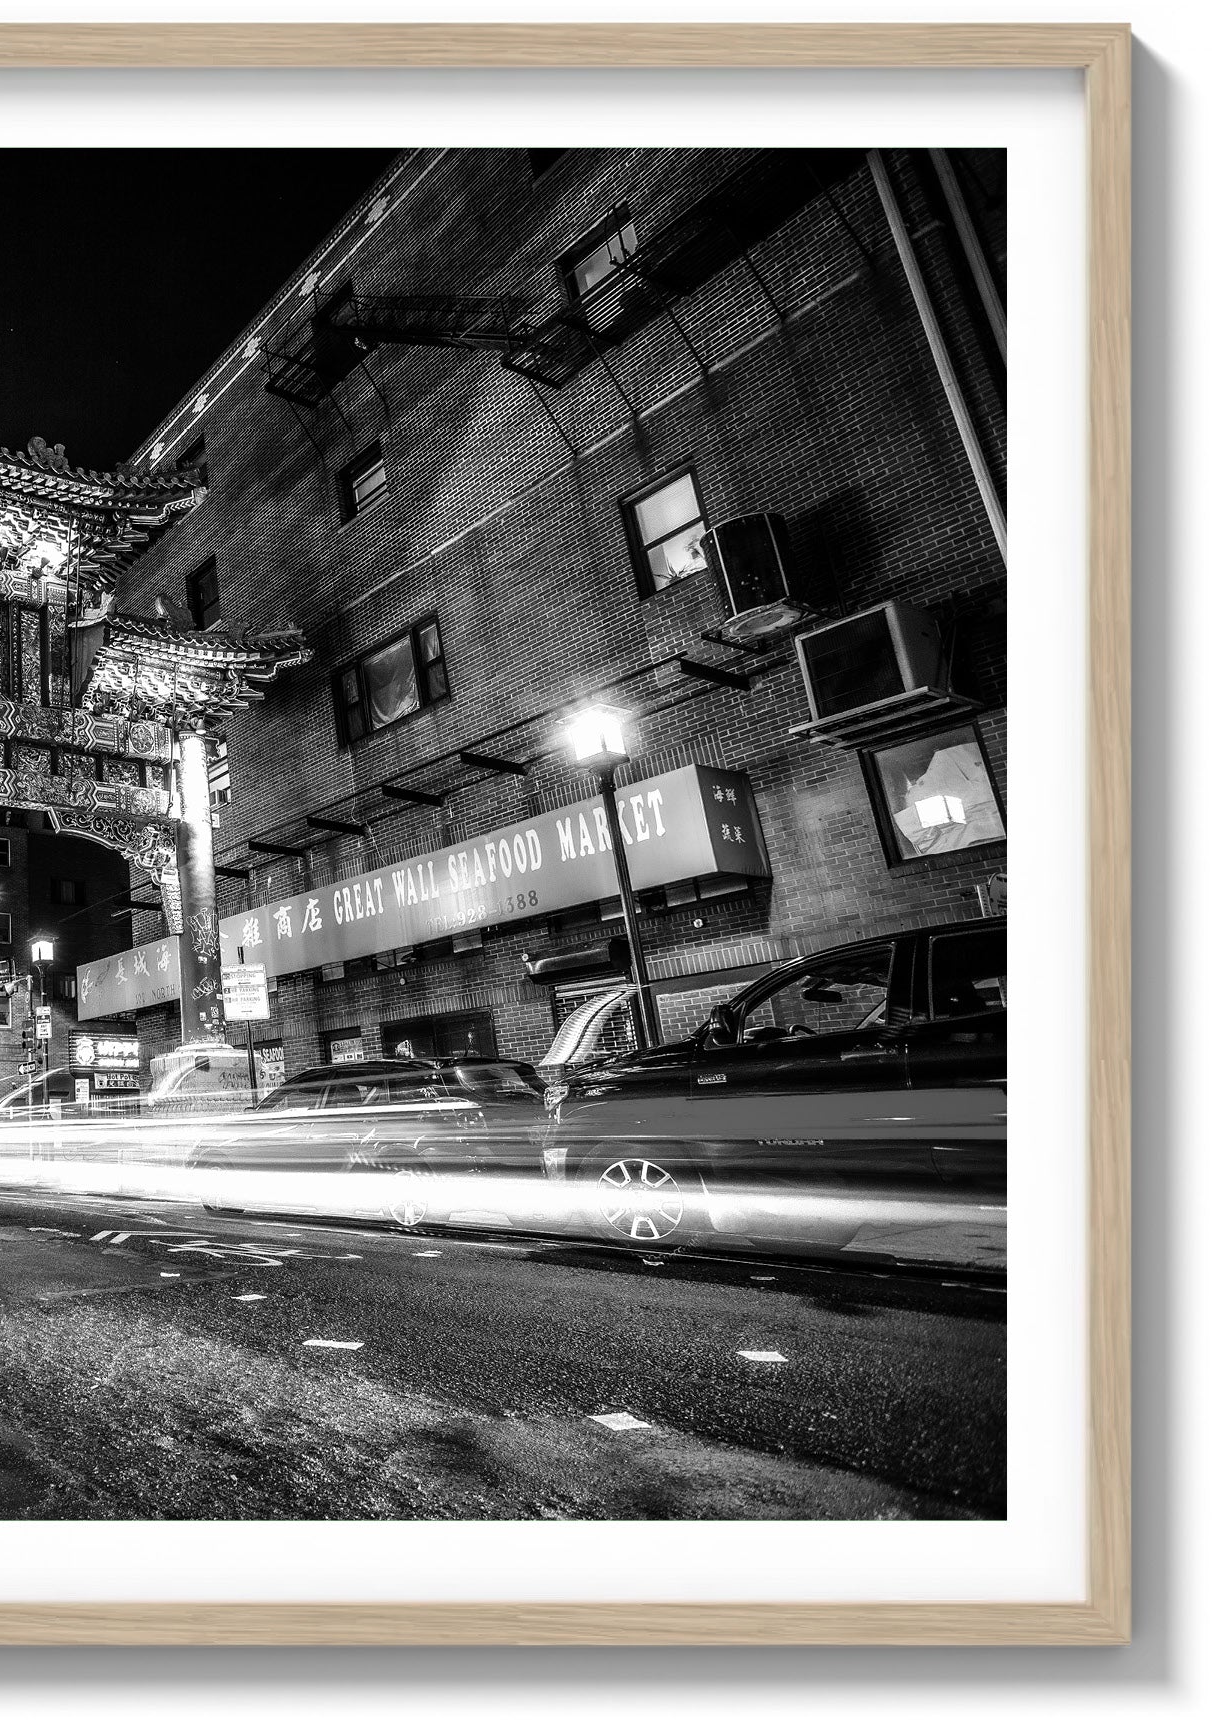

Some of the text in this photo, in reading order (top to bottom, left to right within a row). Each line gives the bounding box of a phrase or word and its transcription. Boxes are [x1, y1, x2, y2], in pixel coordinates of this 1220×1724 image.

[333, 789, 666, 925] GREAT WALL SEAFOOD MARKET
